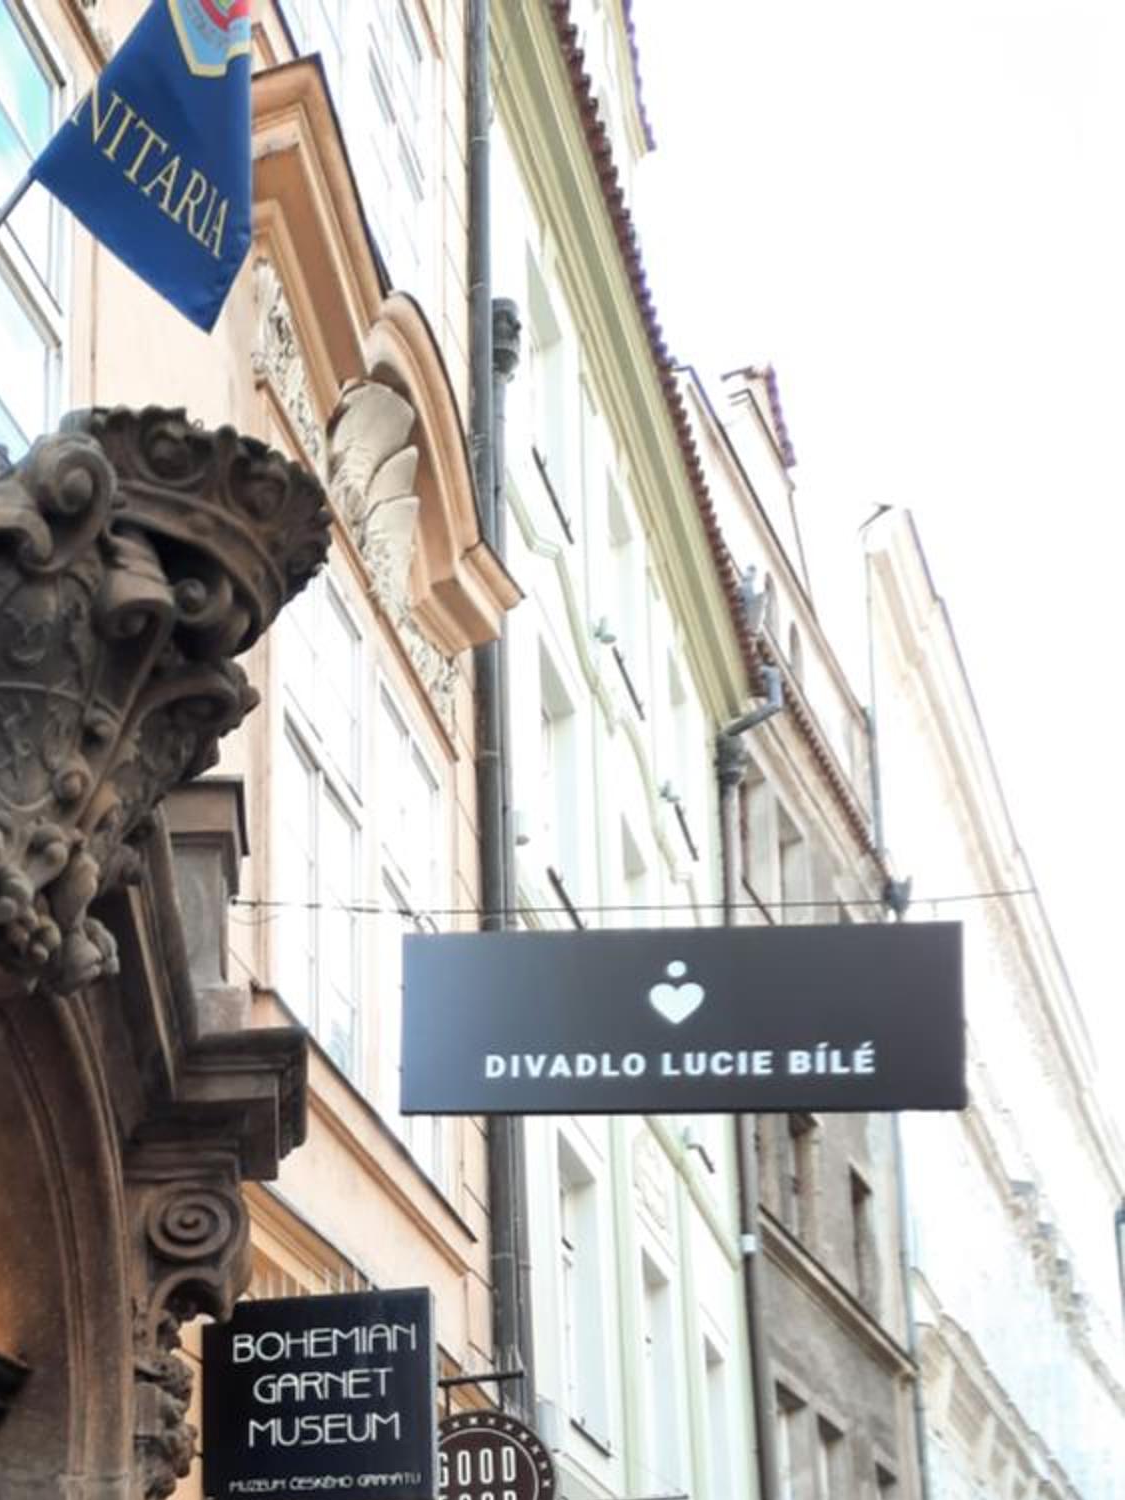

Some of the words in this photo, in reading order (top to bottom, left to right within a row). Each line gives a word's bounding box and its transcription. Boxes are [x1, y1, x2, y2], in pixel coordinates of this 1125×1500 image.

[71, 85, 229, 260] NITARIA
[485, 1051, 646, 1080] DIVADLO
[661, 1049, 773, 1077] LUCIE
[787, 1040, 875, 1074] BÍLÉ
[232, 1322, 417, 1364] BOHEMIAN
[253, 1366, 393, 1404] GARNET
[248, 1412, 401, 1448] MUSEUM
[439, 1446, 517, 1487] GOOD
